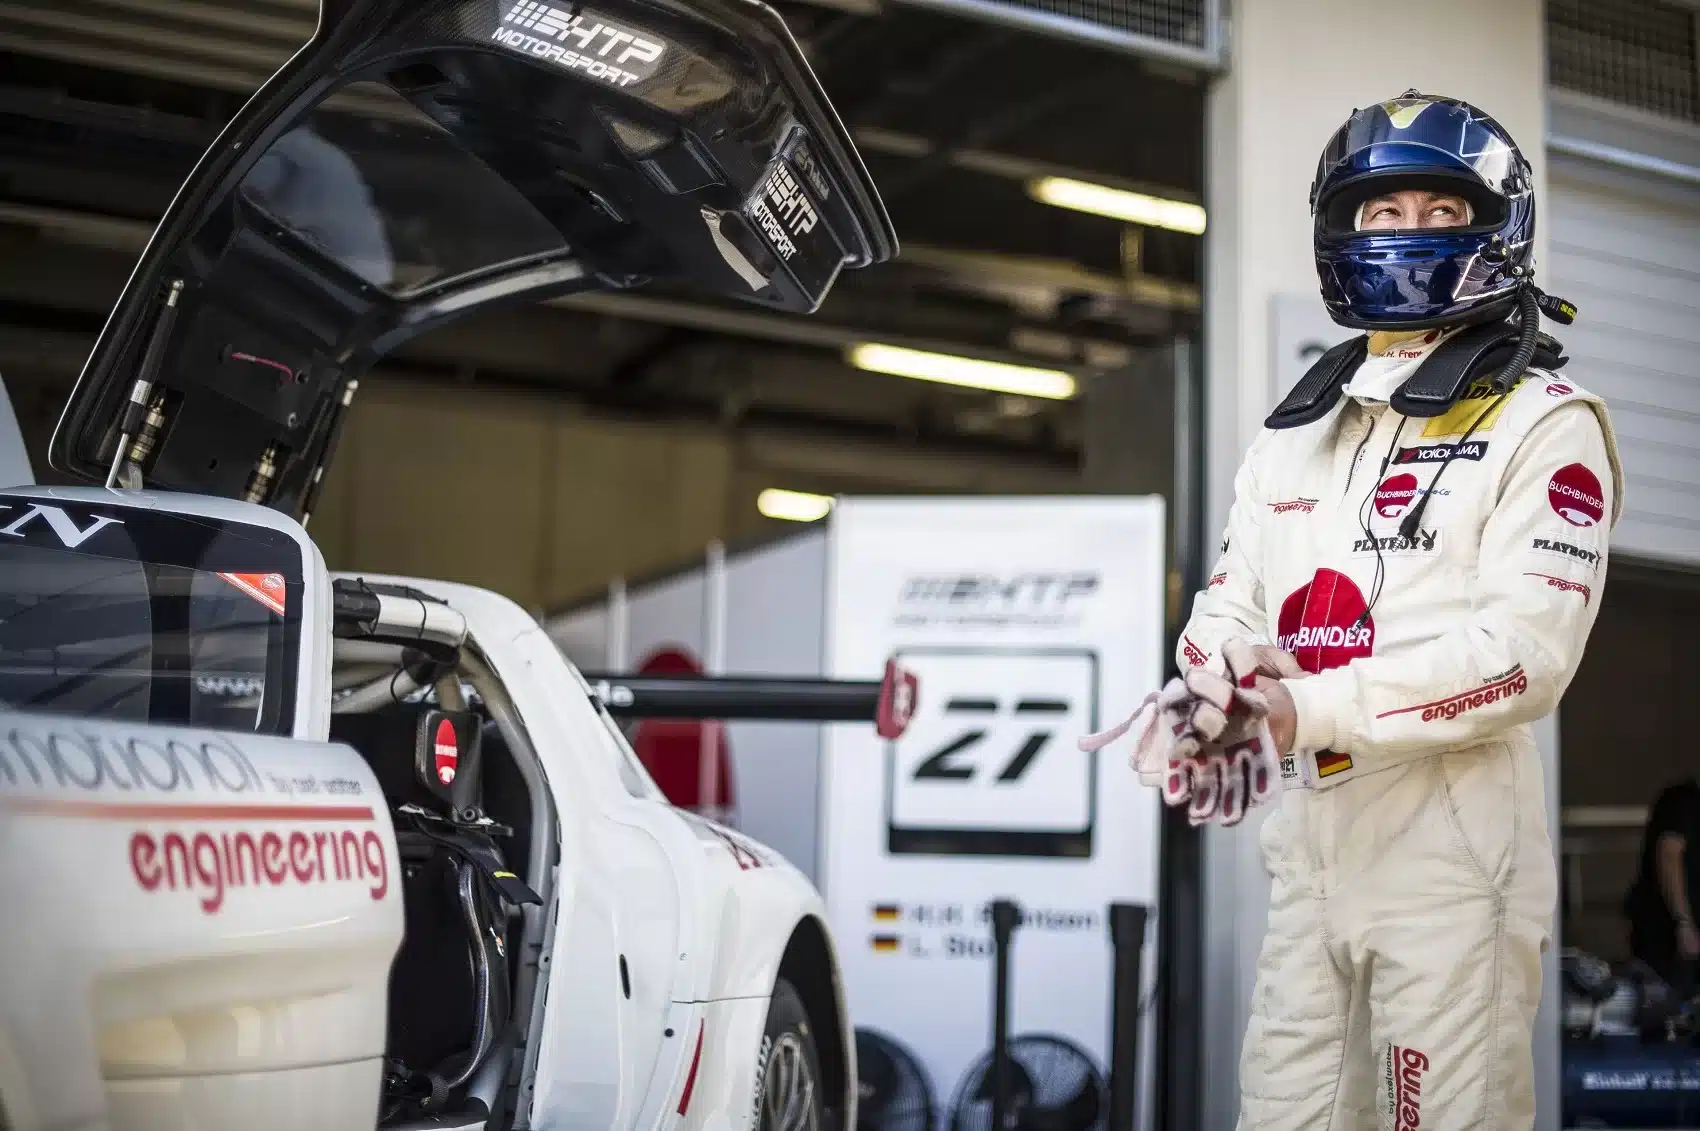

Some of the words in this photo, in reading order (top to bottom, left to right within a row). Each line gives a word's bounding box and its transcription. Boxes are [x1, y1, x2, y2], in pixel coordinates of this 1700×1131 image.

[492, 27, 638, 87] MOTORSPORT
[556, 15, 664, 64] HTP
[751, 198, 797, 261] MOTORSPORT
[1376, 488, 1417, 499] BUCHBINDER
[1548, 480, 1605, 510] BUCHBINDER
[1532, 538, 1597, 564] PLAYBOY
[1421, 675, 1528, 722] engineering
[912, 696, 1071, 783] 27
[129, 829, 389, 915] engineering
[1386, 1076, 1394, 1098] axel
[1388, 1101, 1396, 1114] by
